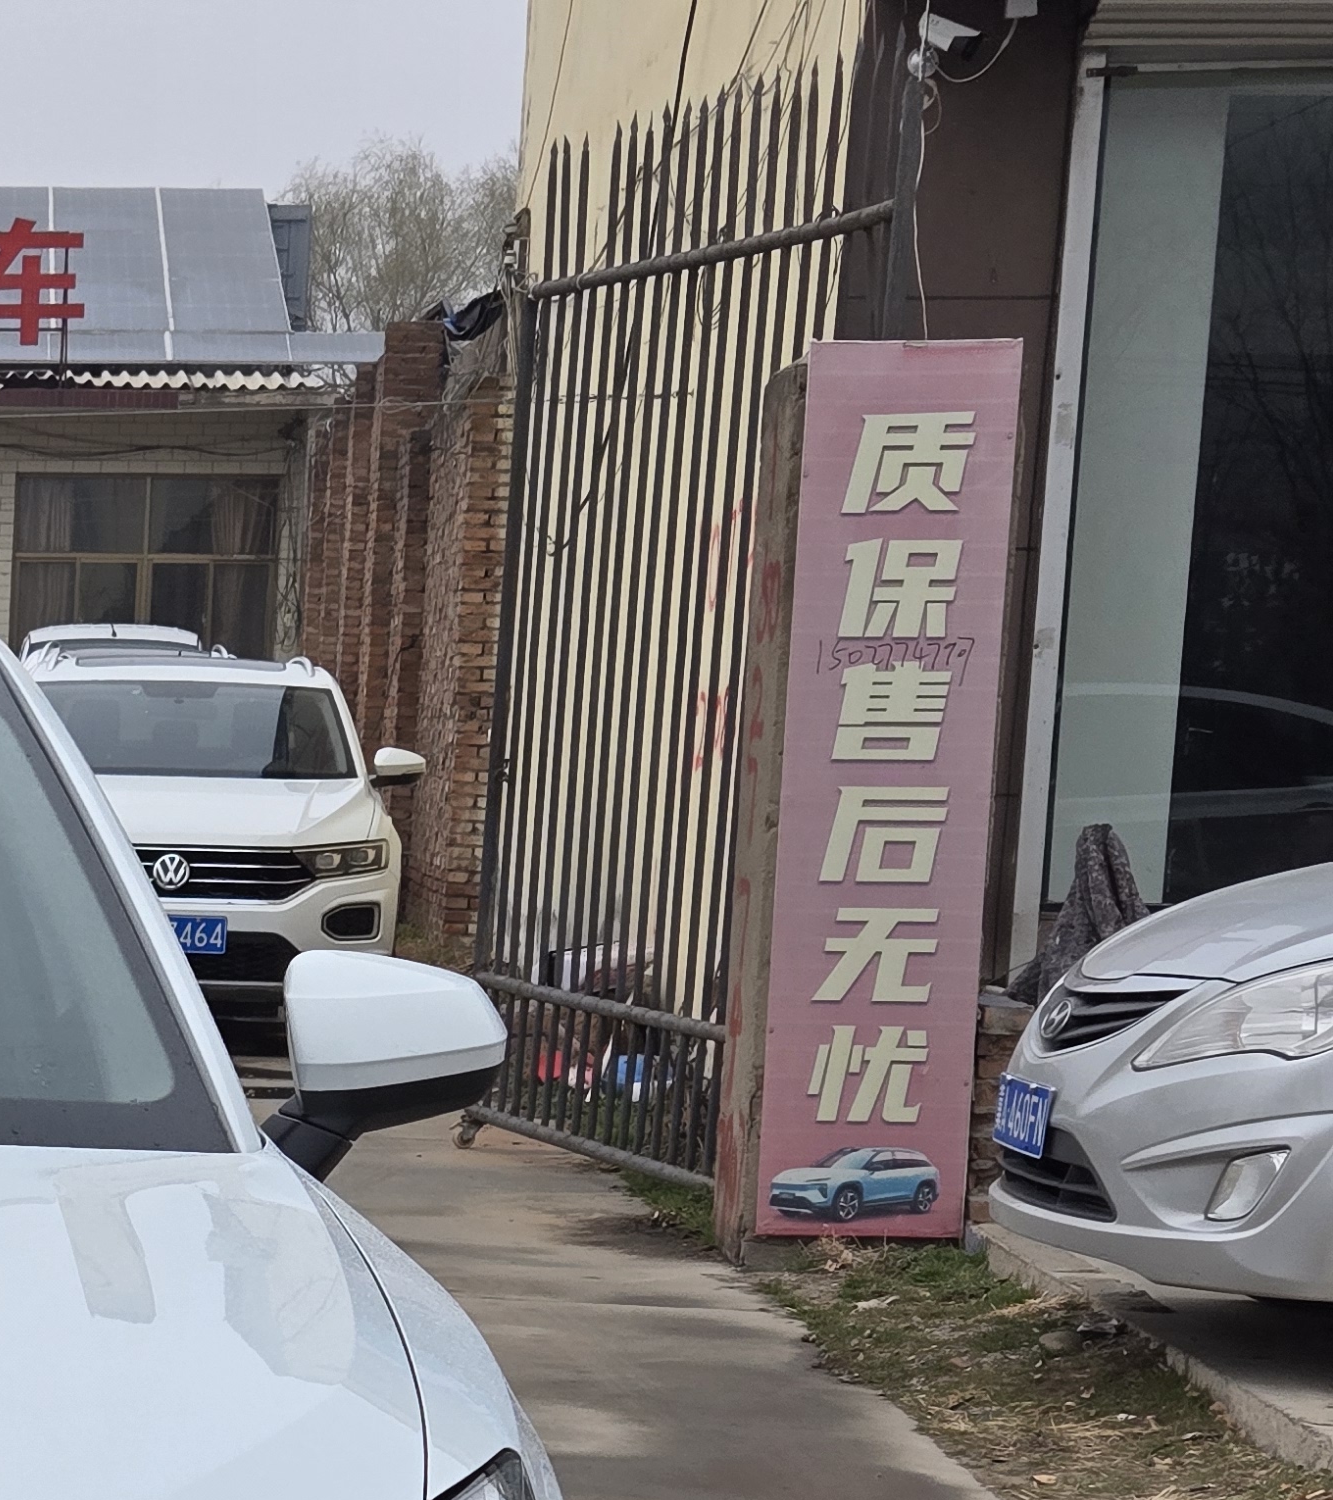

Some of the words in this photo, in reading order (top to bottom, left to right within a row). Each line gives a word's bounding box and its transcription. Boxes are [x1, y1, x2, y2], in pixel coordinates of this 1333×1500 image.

[810, 411, 976, 1125] 质保售后无忧
